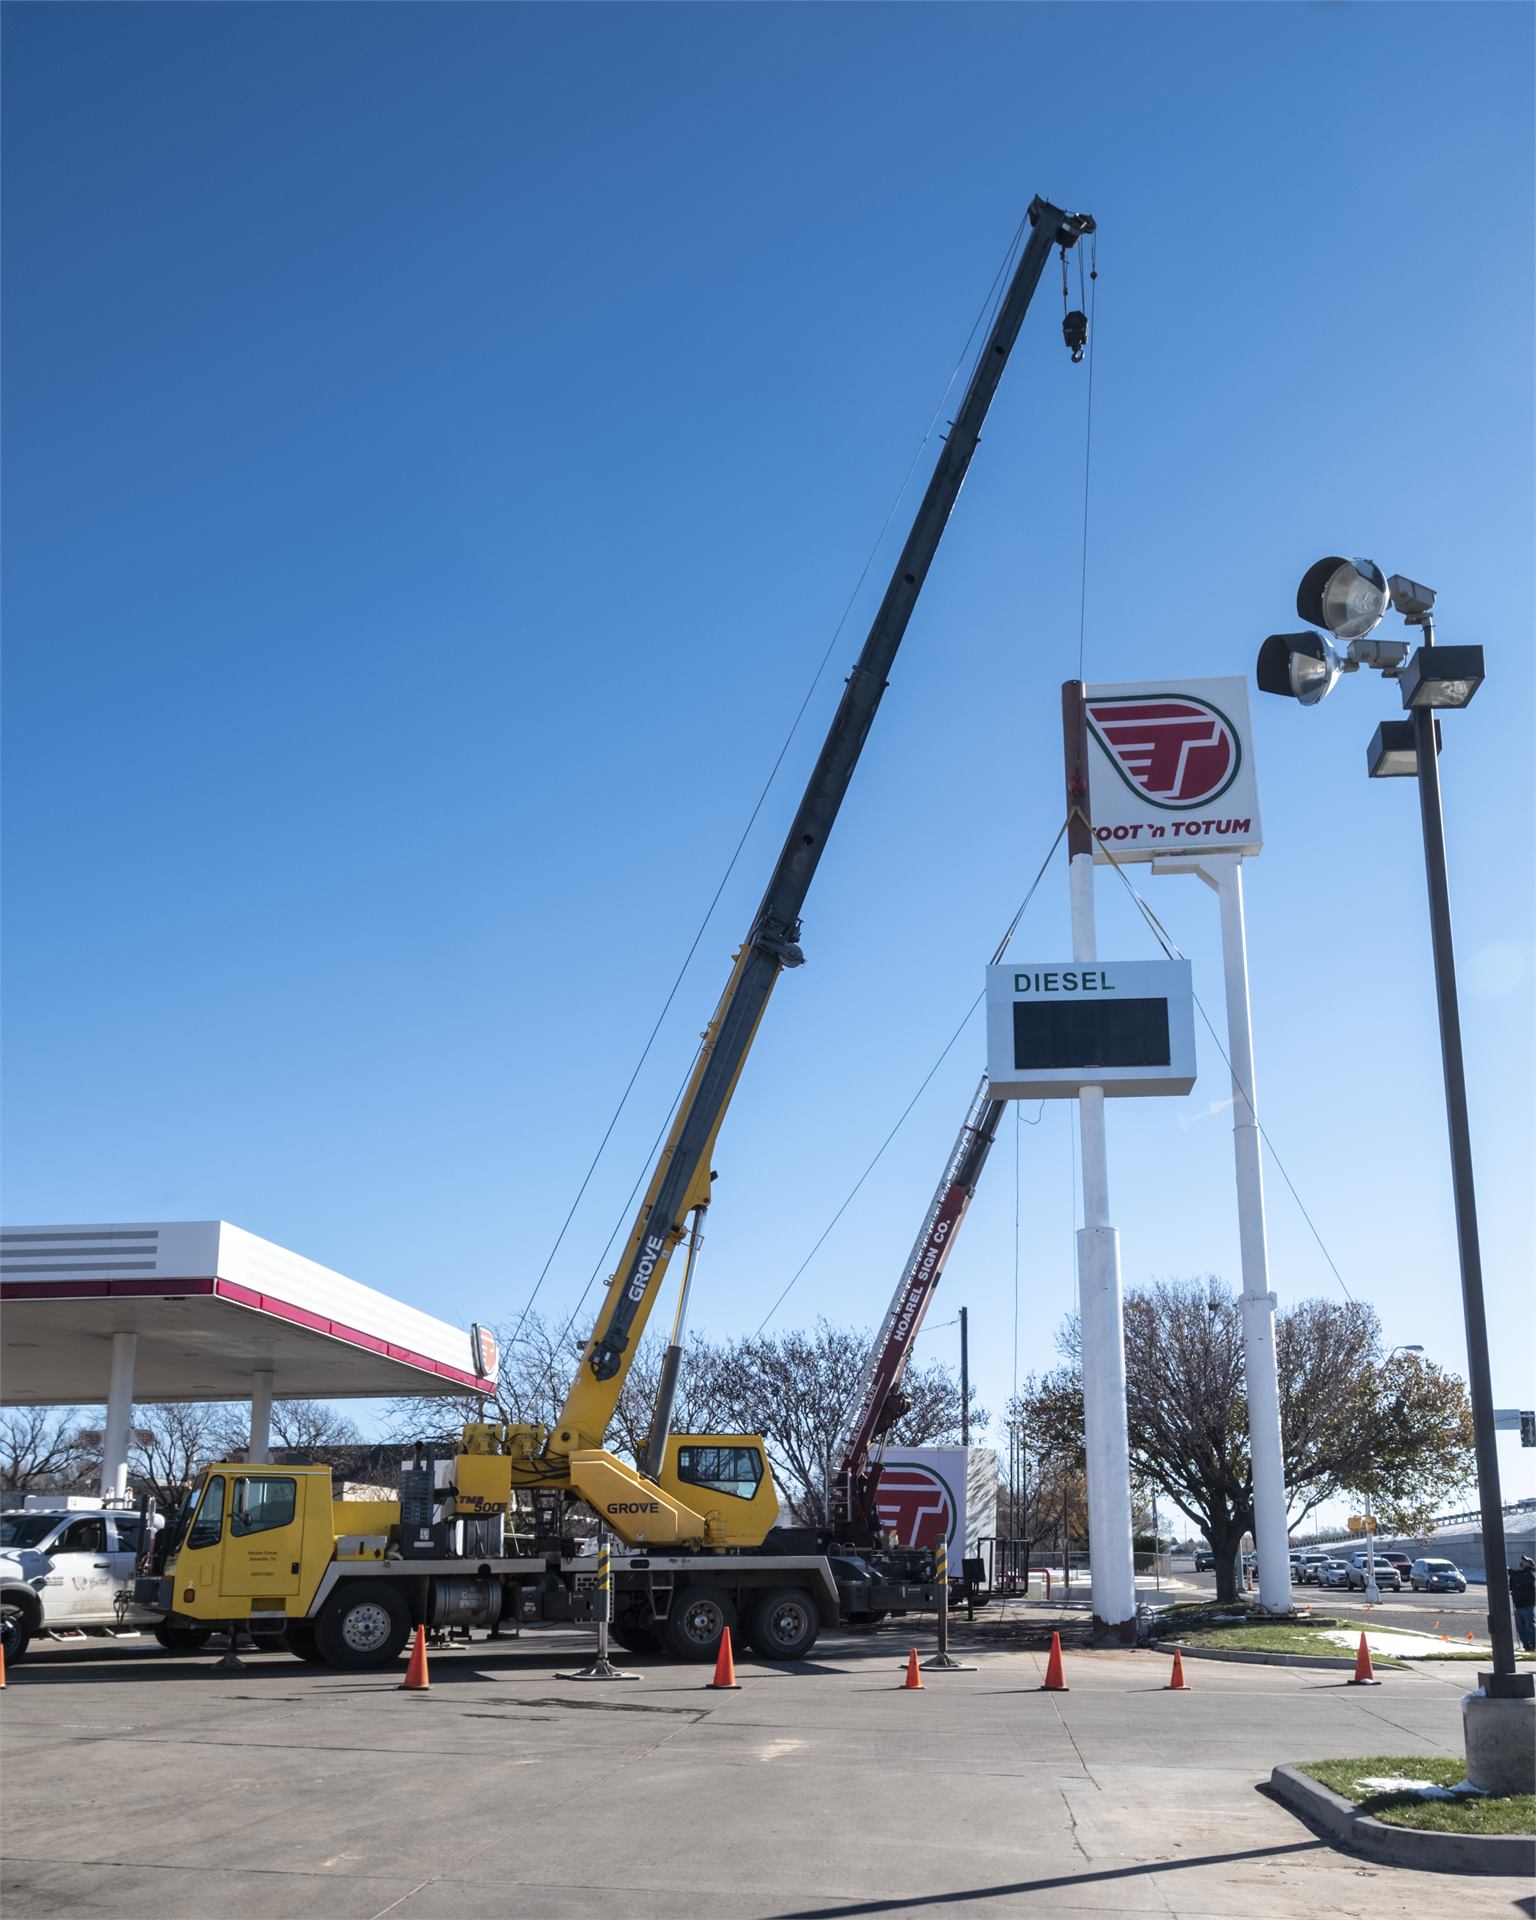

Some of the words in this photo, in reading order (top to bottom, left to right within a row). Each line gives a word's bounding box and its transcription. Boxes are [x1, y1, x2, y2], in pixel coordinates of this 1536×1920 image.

[1171, 818, 1251, 837] TOTUM
[1014, 972, 1116, 993] DIESEL
[627, 1235, 664, 1302] GROVE
[893, 1286, 924, 1342] HOAREL
[918, 1247, 939, 1281] SIGN
[933, 1219, 951, 1244] CO.
[607, 1502, 659, 1514] GROVE
